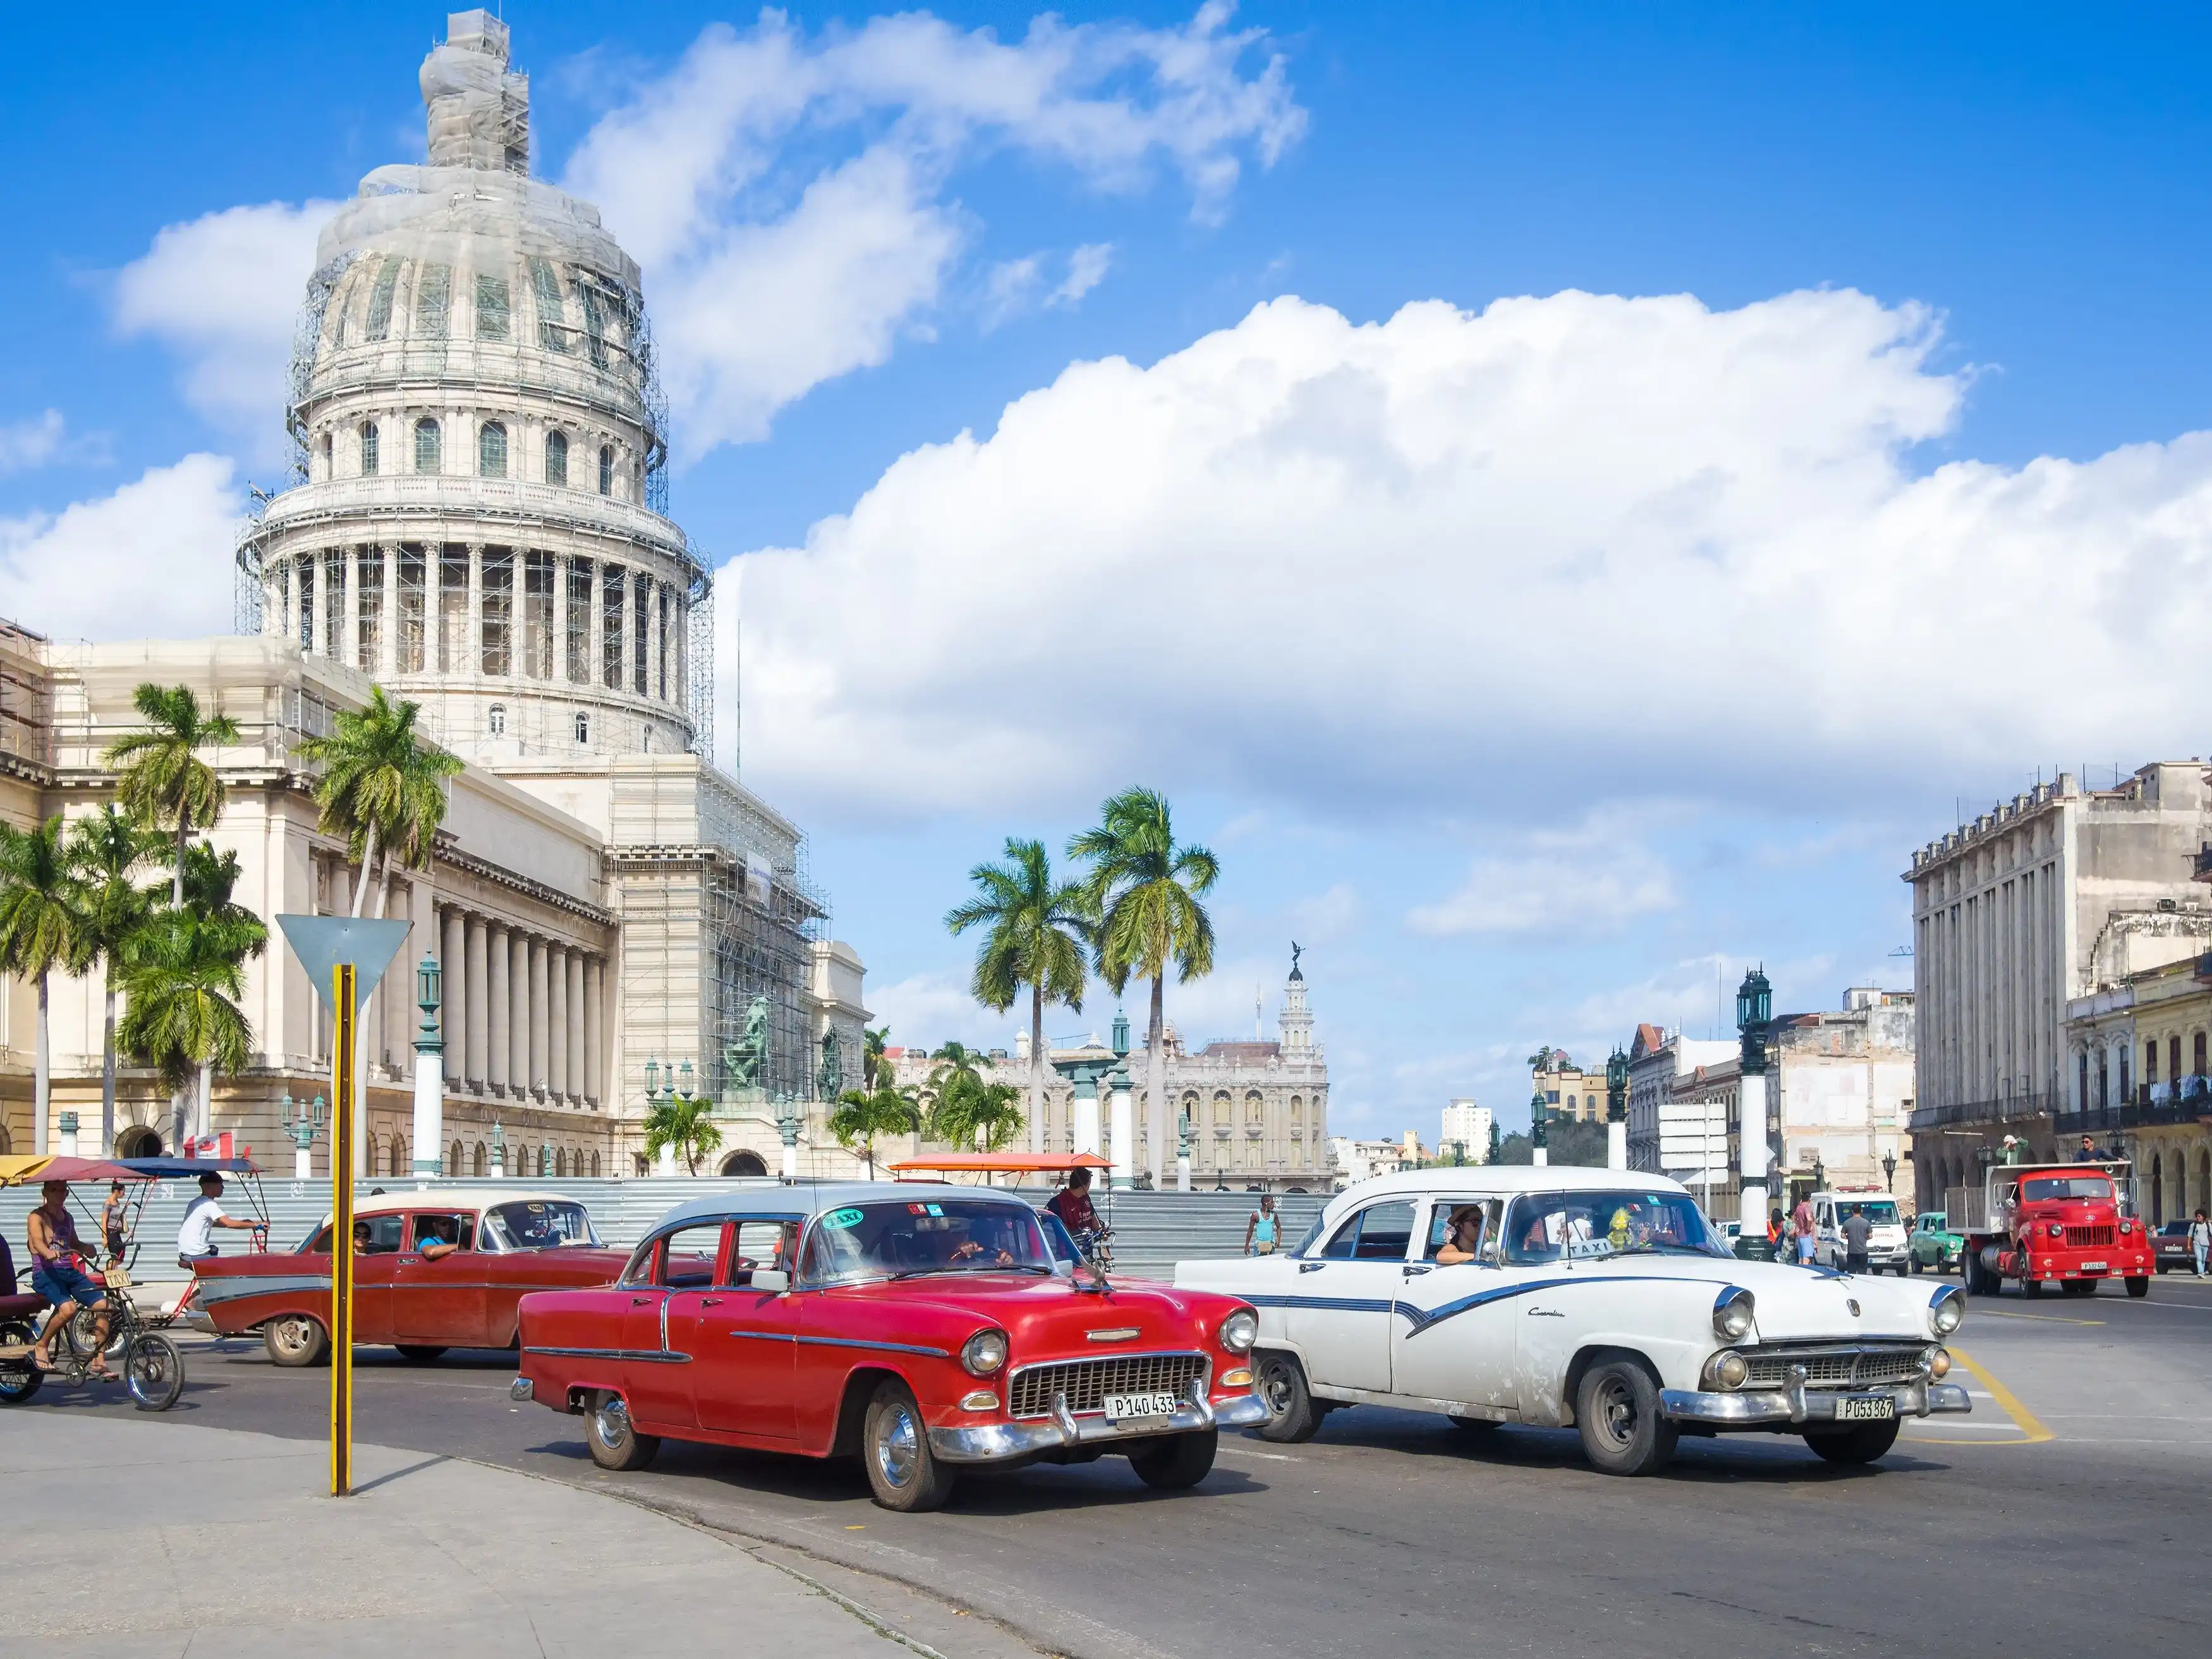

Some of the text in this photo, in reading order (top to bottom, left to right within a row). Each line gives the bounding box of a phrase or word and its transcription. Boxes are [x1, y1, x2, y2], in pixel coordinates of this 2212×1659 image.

[825, 1211, 860, 1226] TAXI
[1570, 1242, 1608, 1254] TAXI
[107, 1272, 130, 1286] TAXI
